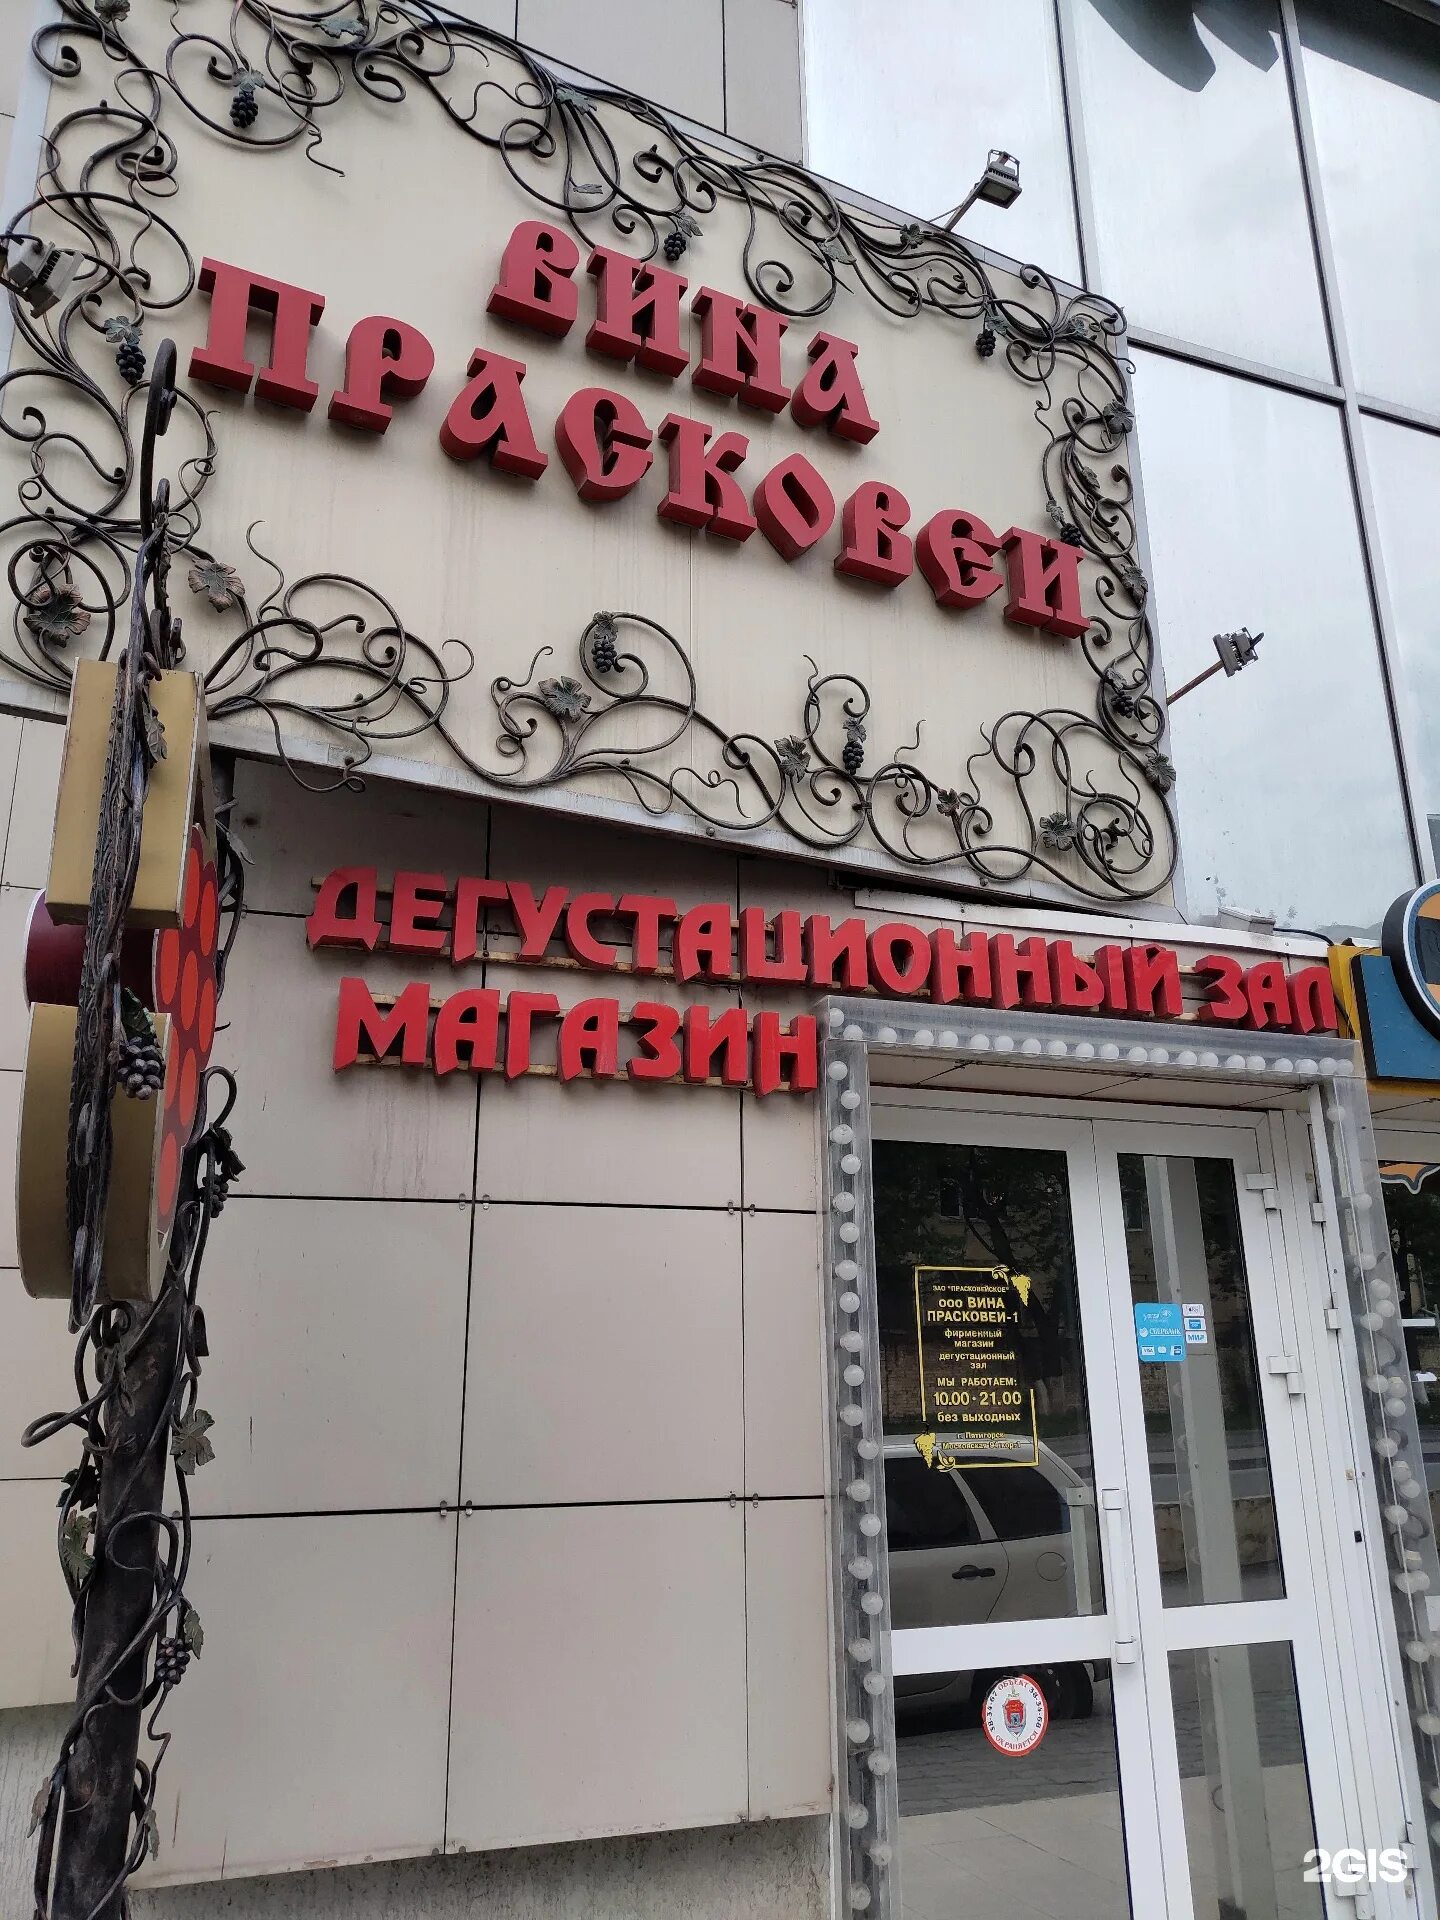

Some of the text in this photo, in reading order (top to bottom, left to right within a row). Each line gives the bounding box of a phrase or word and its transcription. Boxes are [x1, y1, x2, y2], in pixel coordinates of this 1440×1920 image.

[487, 220, 880, 445] ВИНА
[188, 257, 1090, 638] ПРАСКОВЕИ
[305, 867, 1338, 1034] ДЕГУСТАЦИОННЫЙ ЗАЛ
[333, 976, 818, 1097] МАГАЗИН
[967, 1296, 1005, 1309] ВИНА
[927, 1310, 1018, 1323] ПРАСКОВЕИ-1
[944, 1328, 1002, 1338] фирменный
[954, 1340, 994, 1348] магазин
[939, 1351, 1015, 1361] дегустационный
[937, 1377, 1018, 1387] МЫ РАБОТАЕМ:
[937, 1411, 1021, 1422] без выходных
